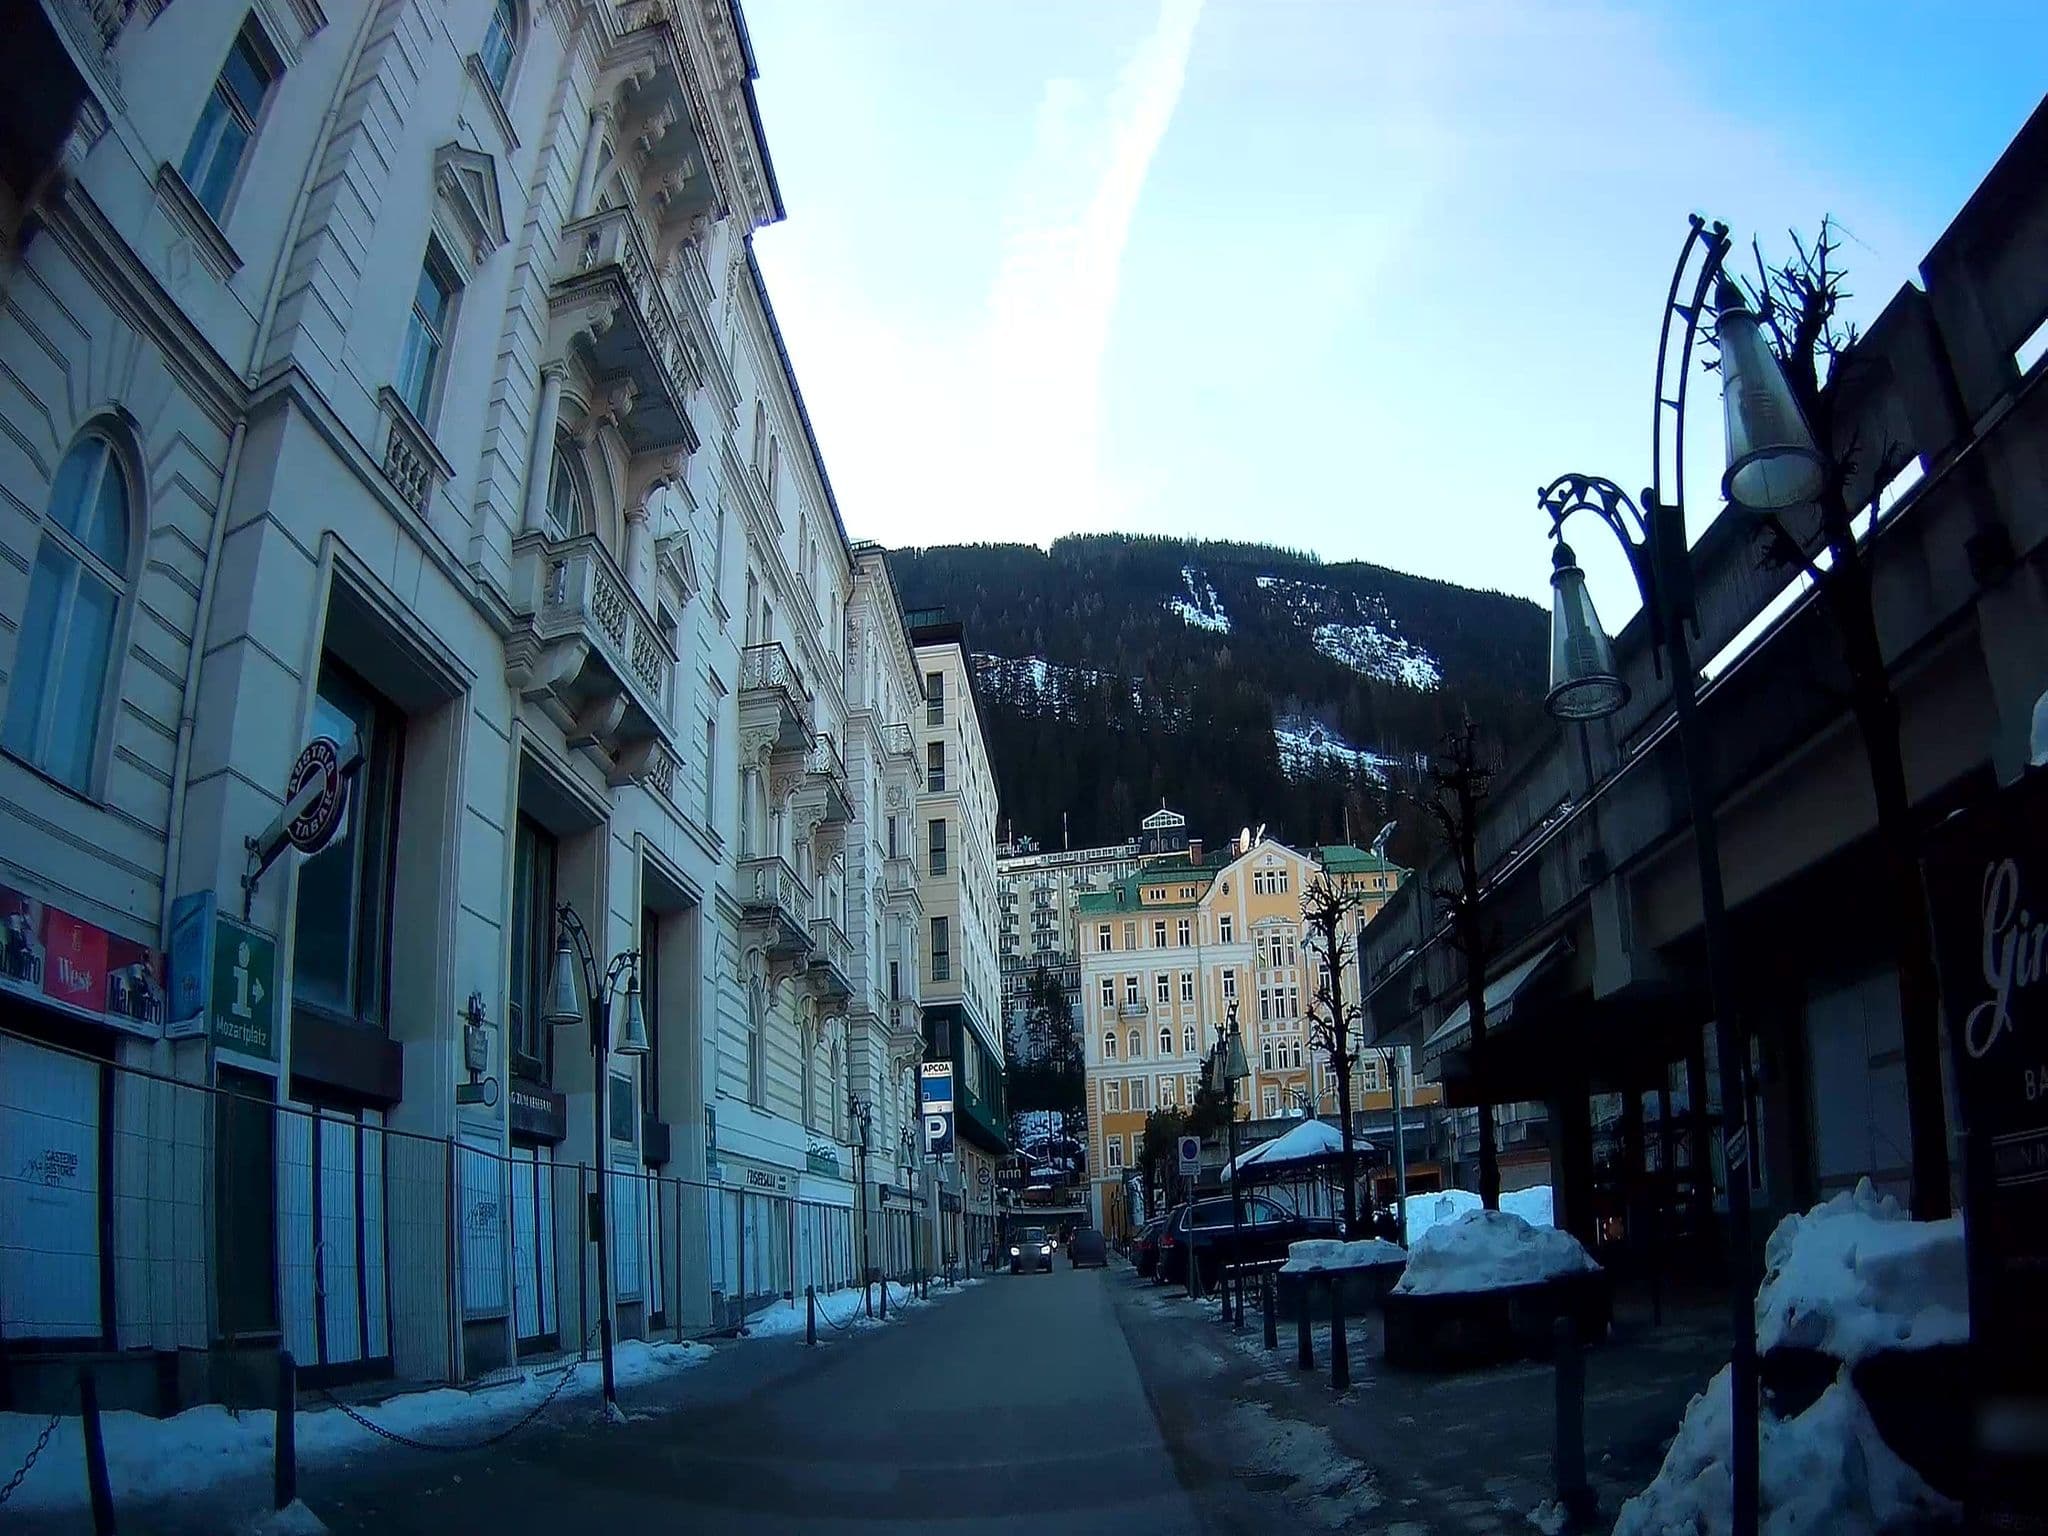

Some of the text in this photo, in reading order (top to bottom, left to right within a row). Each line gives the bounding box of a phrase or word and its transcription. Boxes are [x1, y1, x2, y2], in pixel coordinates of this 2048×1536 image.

[59, 956, 93, 993] West
[110, 974, 161, 1026] Maroro
[215, 1013, 267, 1047] Mozartplatz
[923, 1064, 950, 1074] APCOA
[924, 1115, 948, 1153] P
